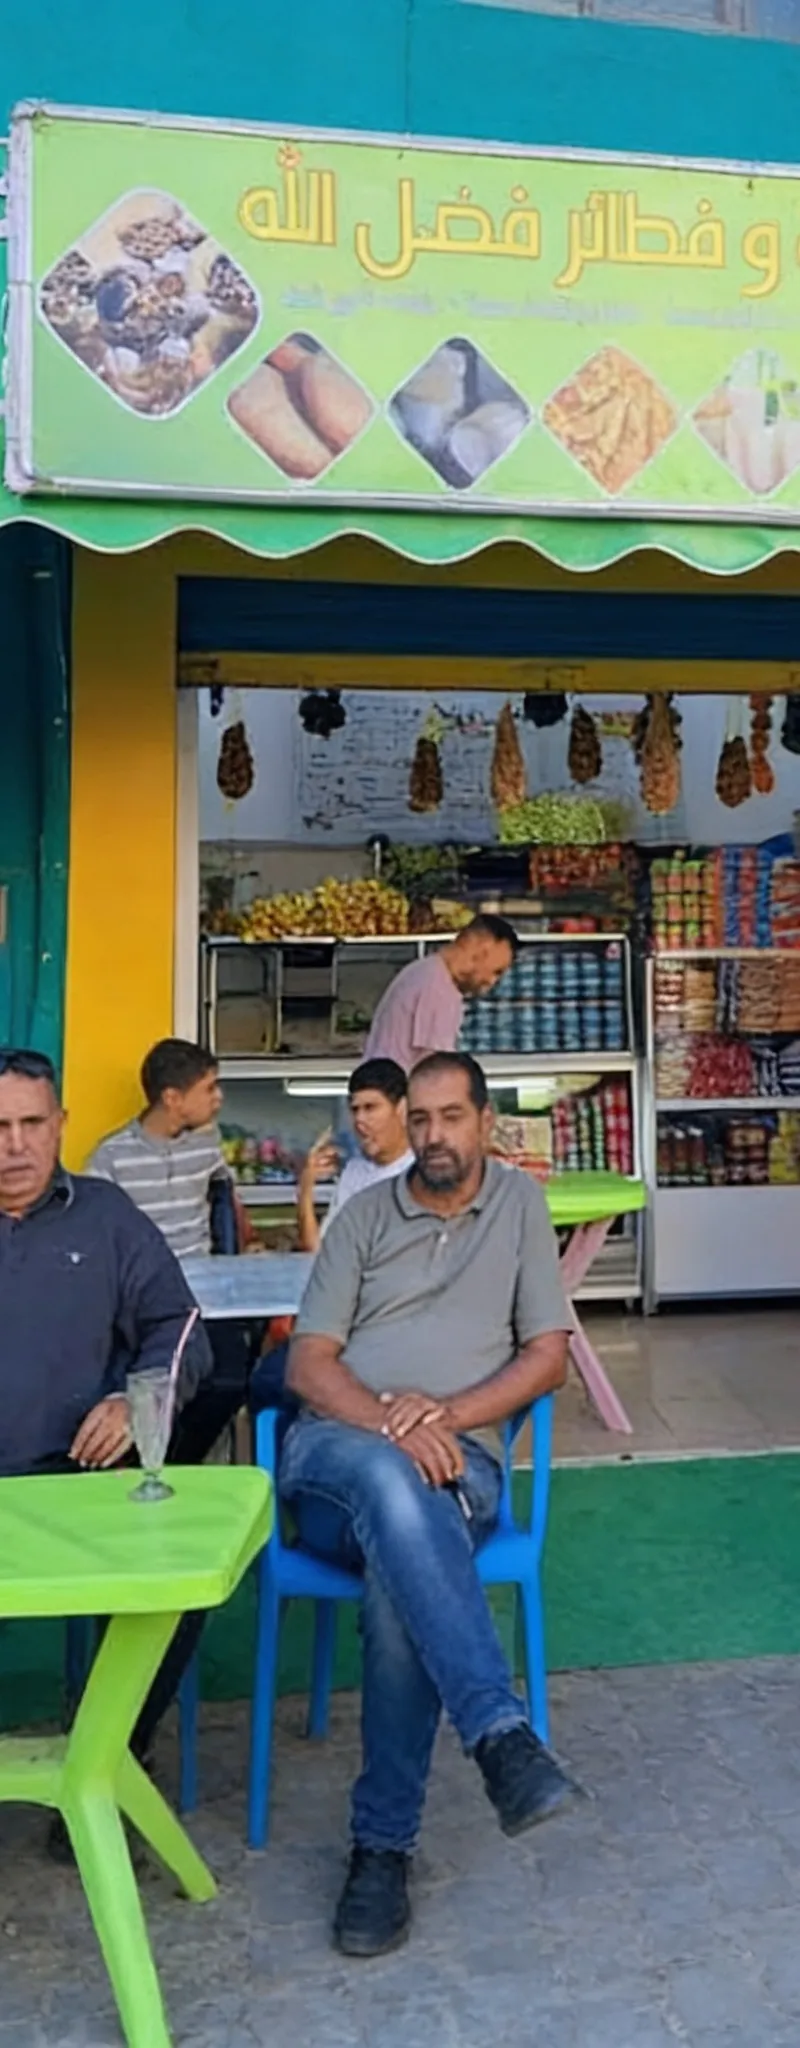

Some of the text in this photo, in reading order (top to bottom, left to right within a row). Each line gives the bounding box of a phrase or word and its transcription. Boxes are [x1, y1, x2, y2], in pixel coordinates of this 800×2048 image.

[237, 142, 338, 248] الله
[353, 177, 542, 281] فضل
[552, 189, 727, 289] فطائر
[741, 219, 781, 299] و
